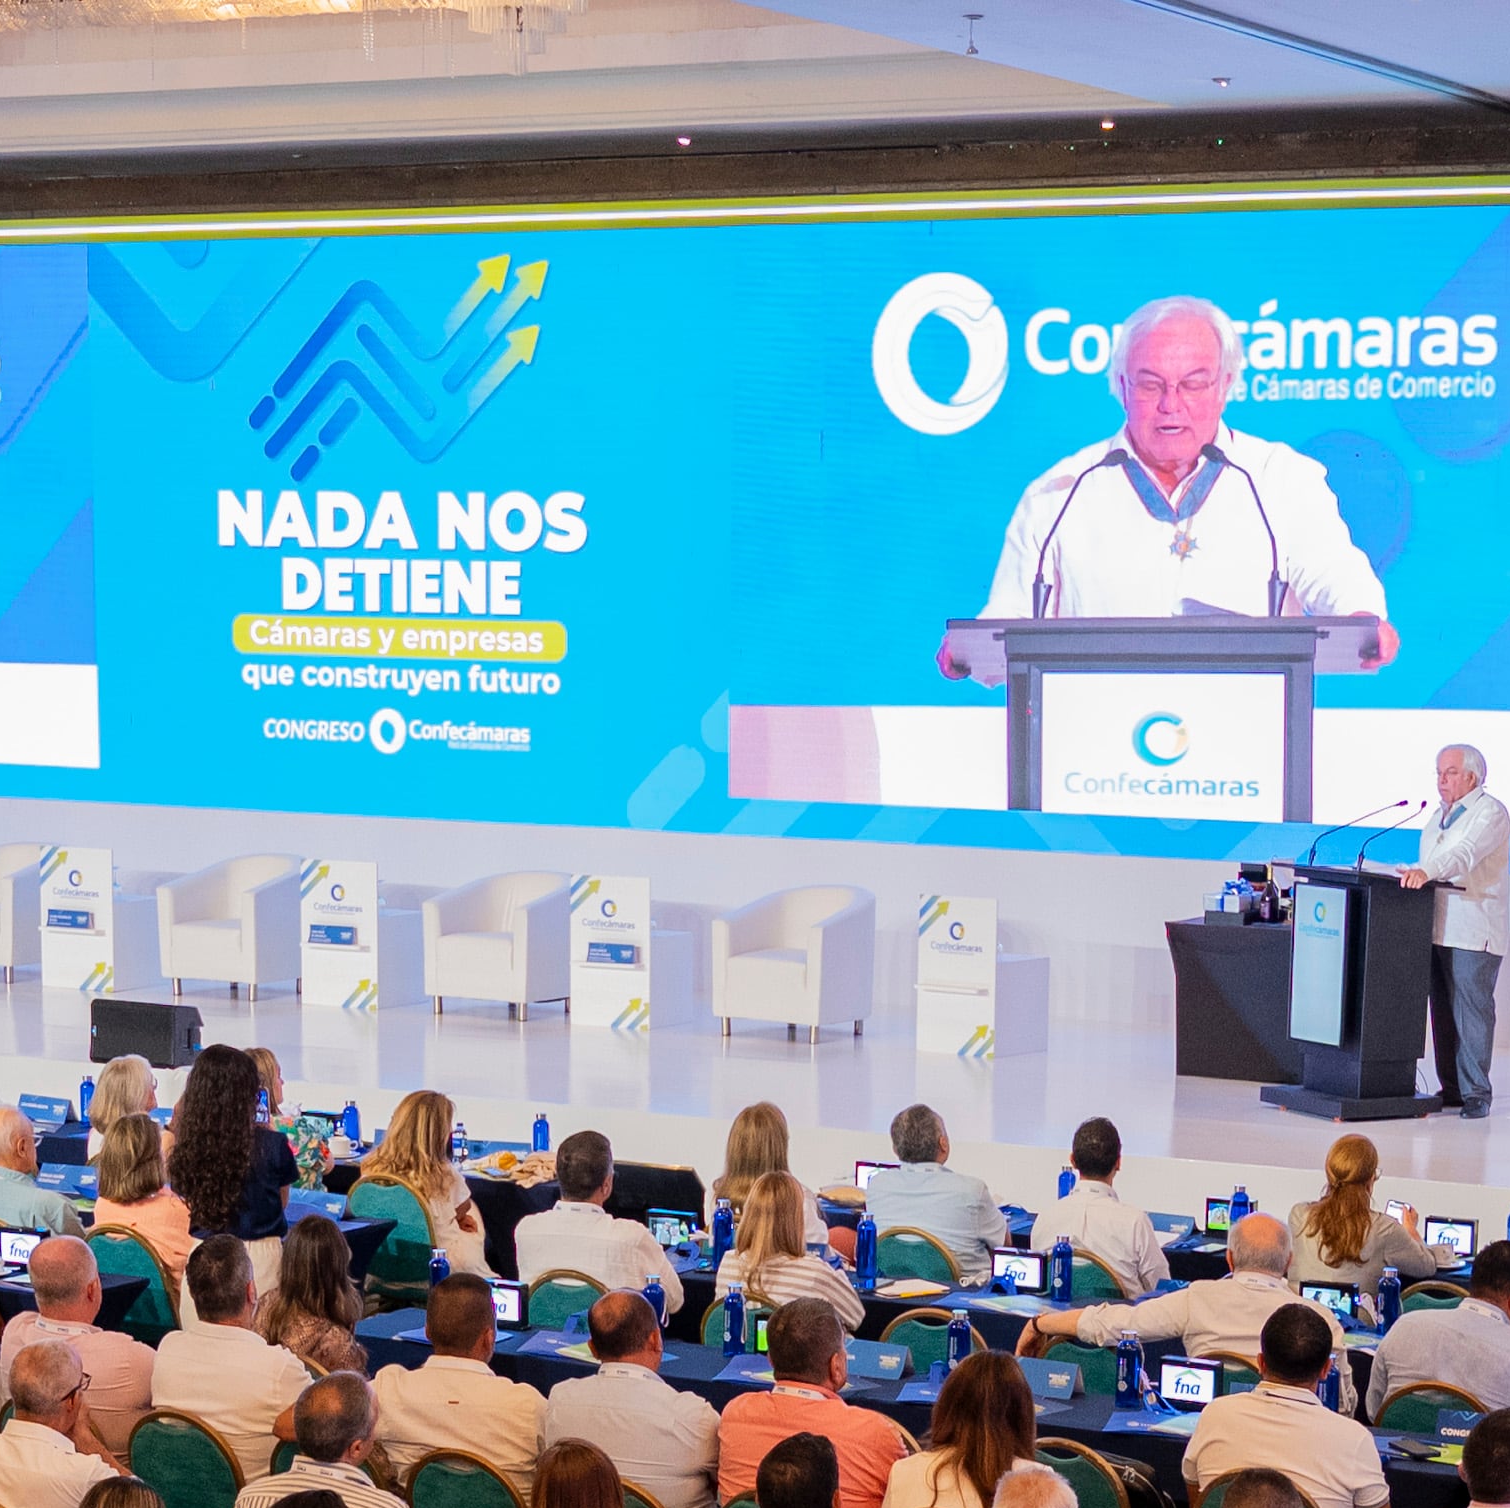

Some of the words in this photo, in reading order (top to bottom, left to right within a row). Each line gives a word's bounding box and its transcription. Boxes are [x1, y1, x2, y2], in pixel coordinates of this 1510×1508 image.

[1251, 372, 1350, 402] Cámaras
[1354, 373, 1382, 400] de
[1387, 371, 1496, 398] Comercio
[217, 490, 418, 551] NADA
[437, 492, 589, 552] NOS
[281, 557, 522, 616] DETIENE
[249, 618, 372, 646] Cámaras
[378, 627, 395, 654] y
[401, 629, 544, 656] empresas
[241, 663, 295, 691] que
[300, 664, 461, 697] construyen
[467, 664, 562, 695] futuro
[263, 718, 366, 742] CONGRESO
[408, 720, 531, 744] Confecámaras
[1065, 770, 1260, 798] Confecámaras
[9, 1242, 29, 1259] fna
[1437, 1230, 1459, 1246] fna
[1173, 1376, 1199, 1396] fna
